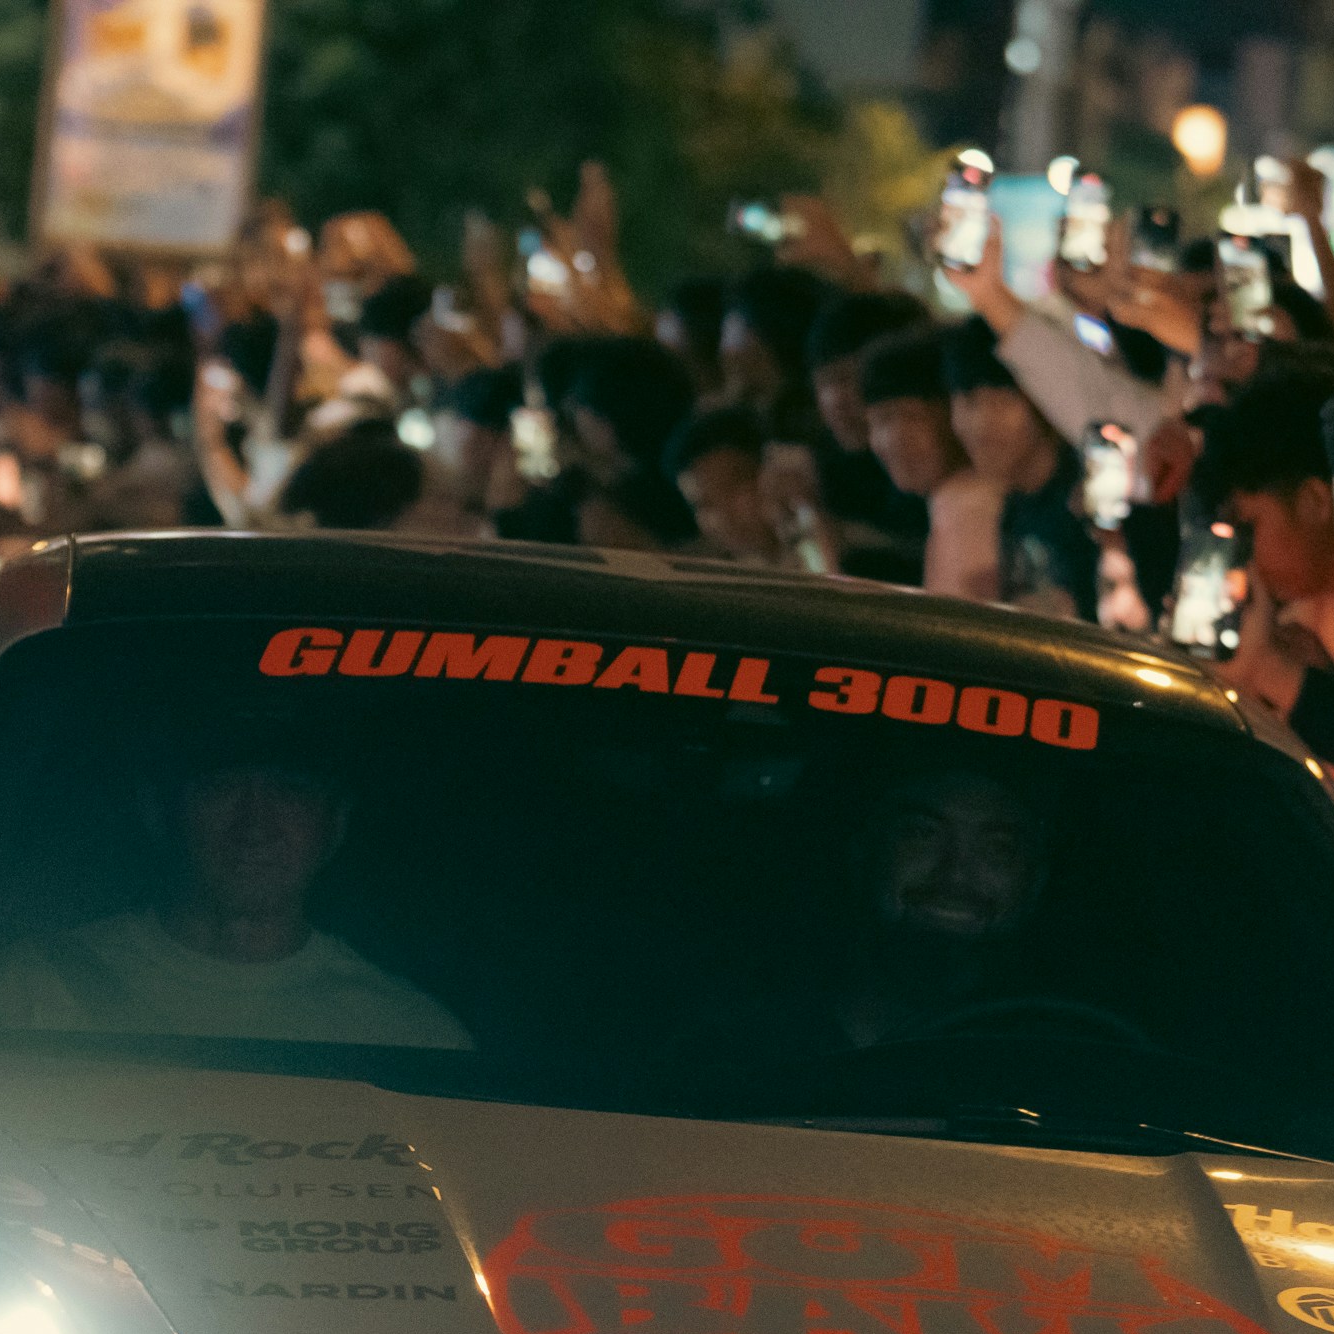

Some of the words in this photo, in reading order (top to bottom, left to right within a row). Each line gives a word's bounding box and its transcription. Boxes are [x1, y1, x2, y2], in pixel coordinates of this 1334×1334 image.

[259, 627, 780, 705] GUMBALL
[809, 665, 1100, 752] 3000
[180, 1132, 416, 1167] Rock
[163, 1182, 435, 1200] OLUFSEN
[240, 1220, 441, 1240] MONG
[240, 1238, 443, 1255] GROUP
[202, 1280, 457, 1303] NARDIN
